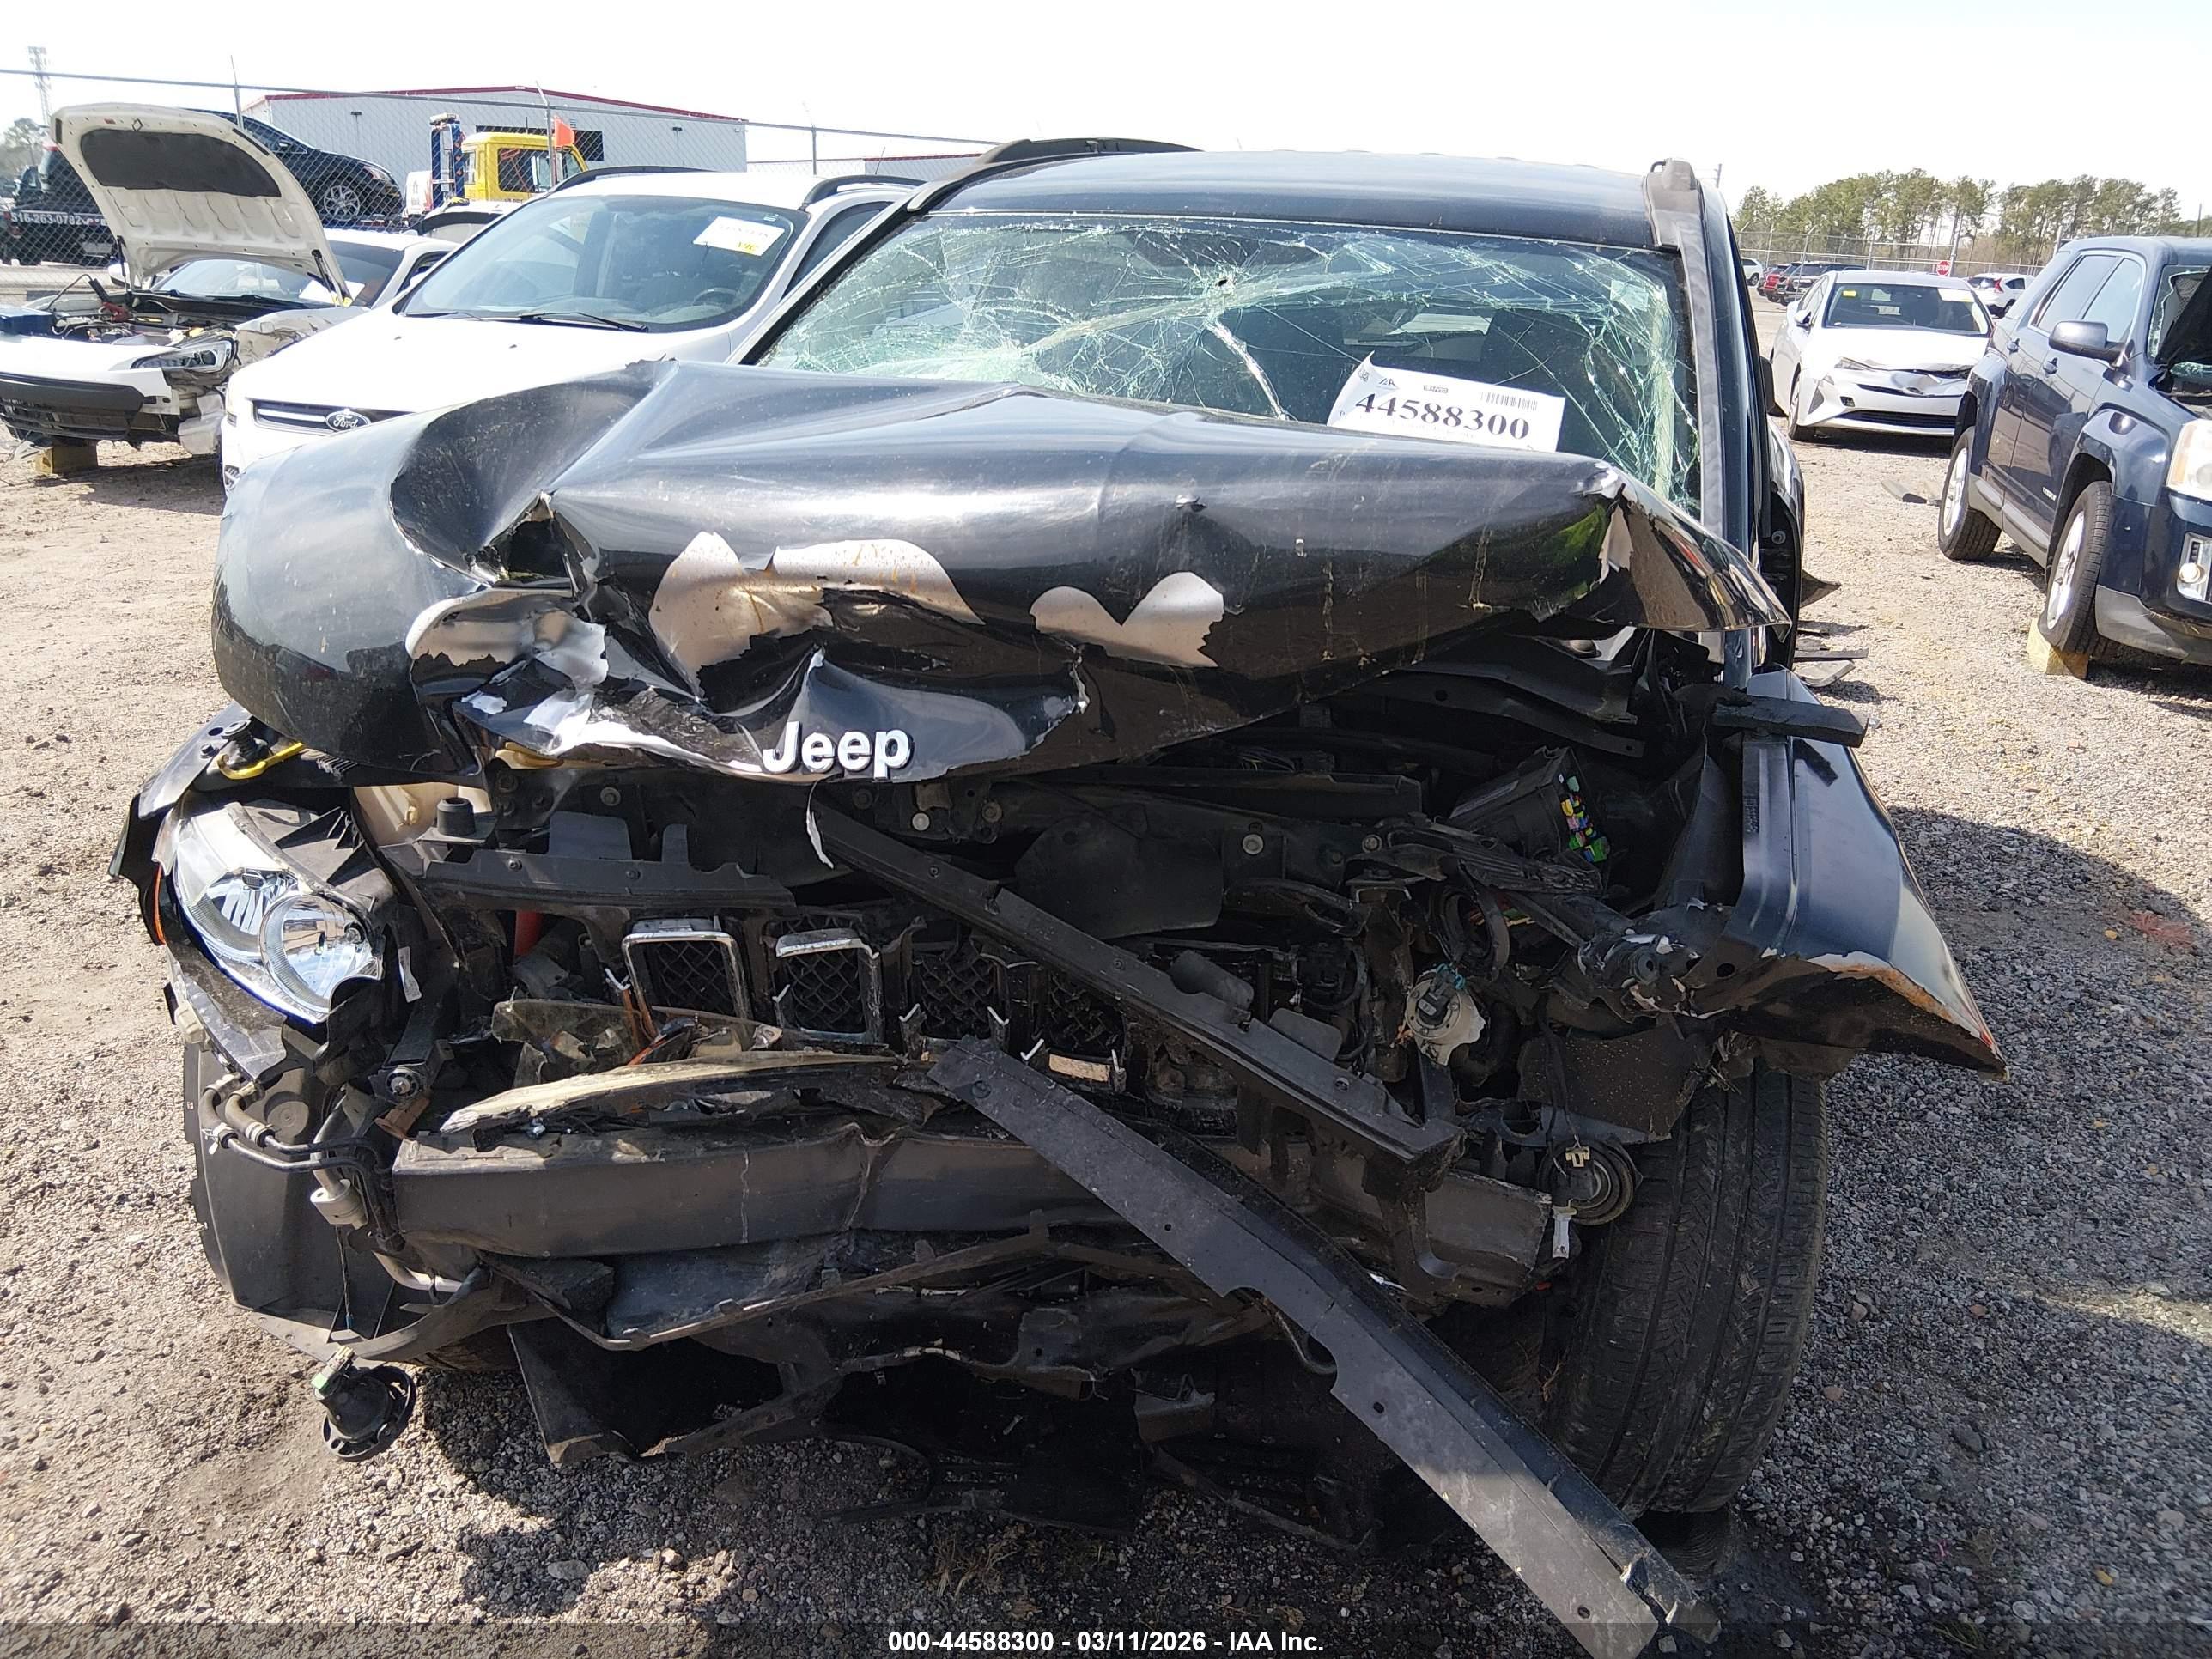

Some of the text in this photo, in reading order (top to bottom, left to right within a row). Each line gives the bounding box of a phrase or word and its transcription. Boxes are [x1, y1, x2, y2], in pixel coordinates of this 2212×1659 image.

[333, 415, 359, 428] Ford
[1355, 393, 1529, 440] 44588300
[763, 720, 913, 780] Jeep
